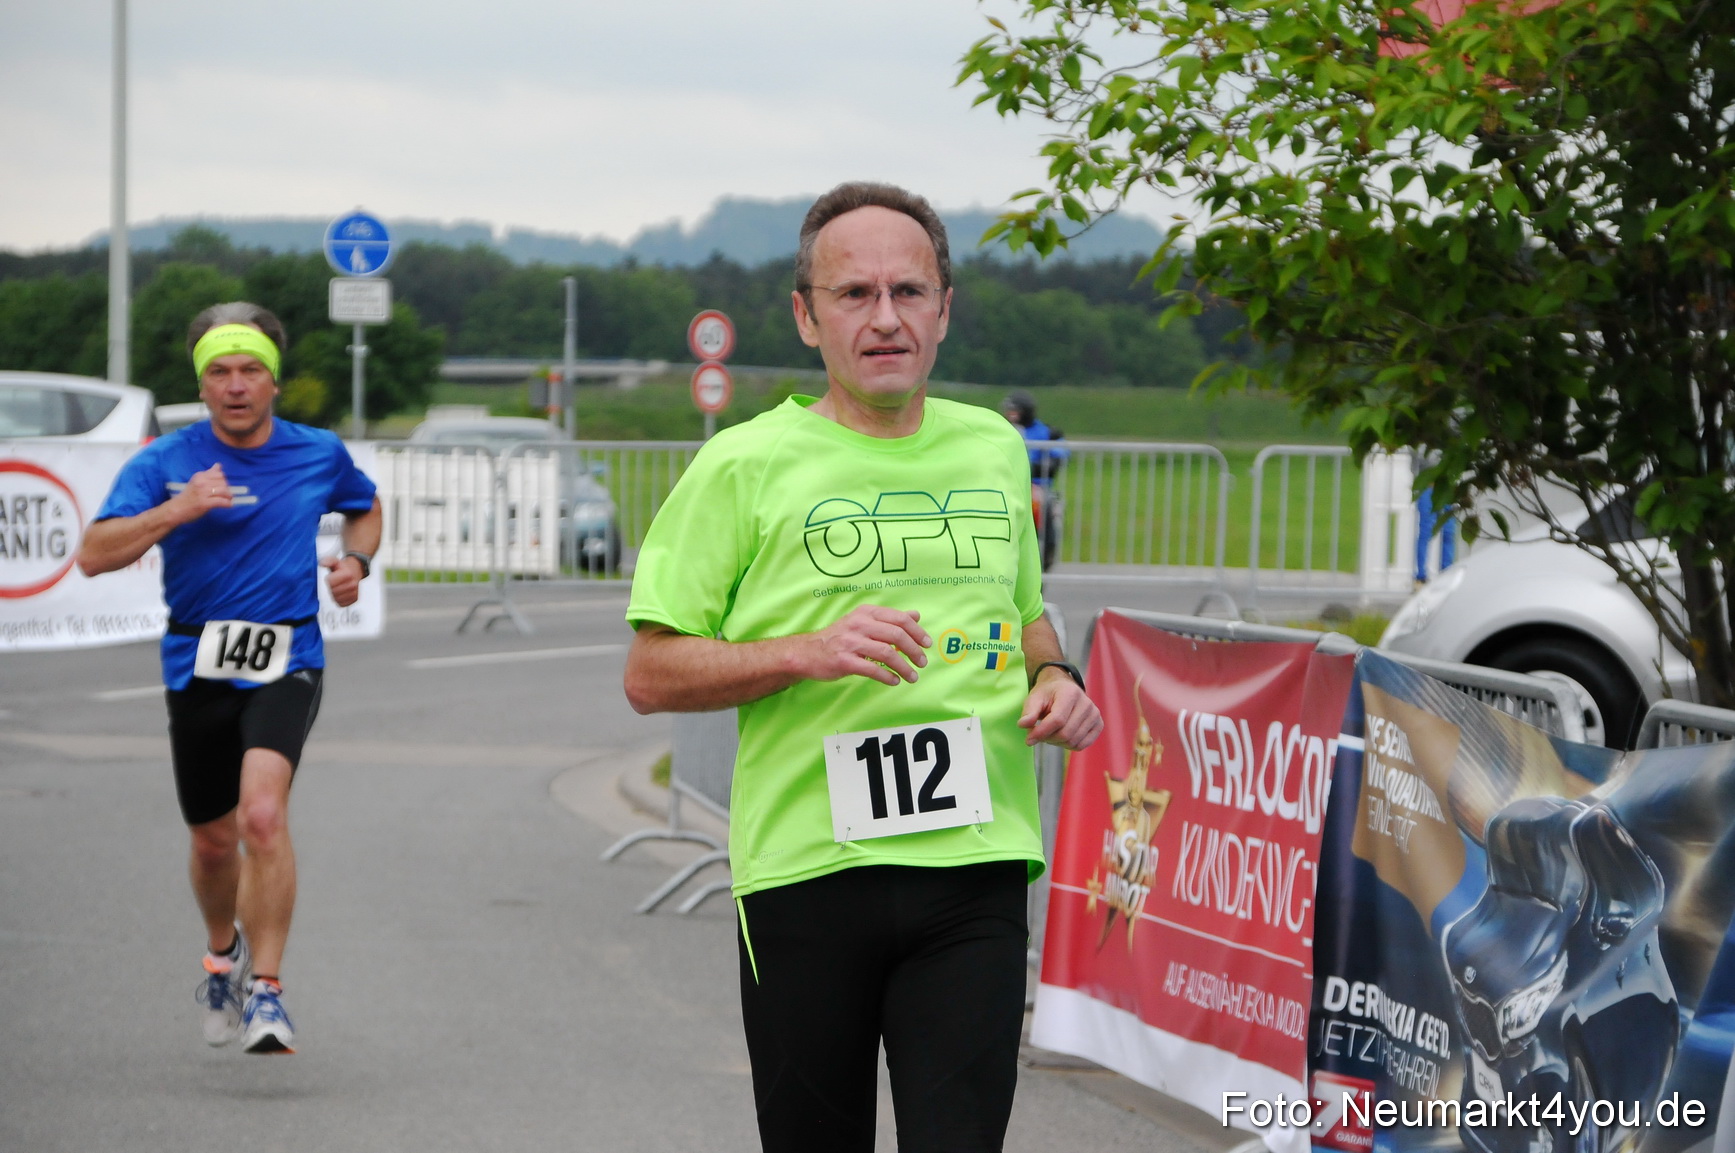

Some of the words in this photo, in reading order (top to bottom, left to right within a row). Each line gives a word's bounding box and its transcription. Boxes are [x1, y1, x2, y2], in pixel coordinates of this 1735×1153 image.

[812, 584, 862, 598] Gebäude-
[864, 580, 883, 591] und
[885, 574, 996, 588] Automatisierungstechnik
[214, 624, 276, 671] 148
[946, 636, 1016, 654] Bretschneider
[855, 727, 957, 820] 112
[1323, 975, 1380, 1020] DER
[1391, 1000, 1416, 1043] KIA
